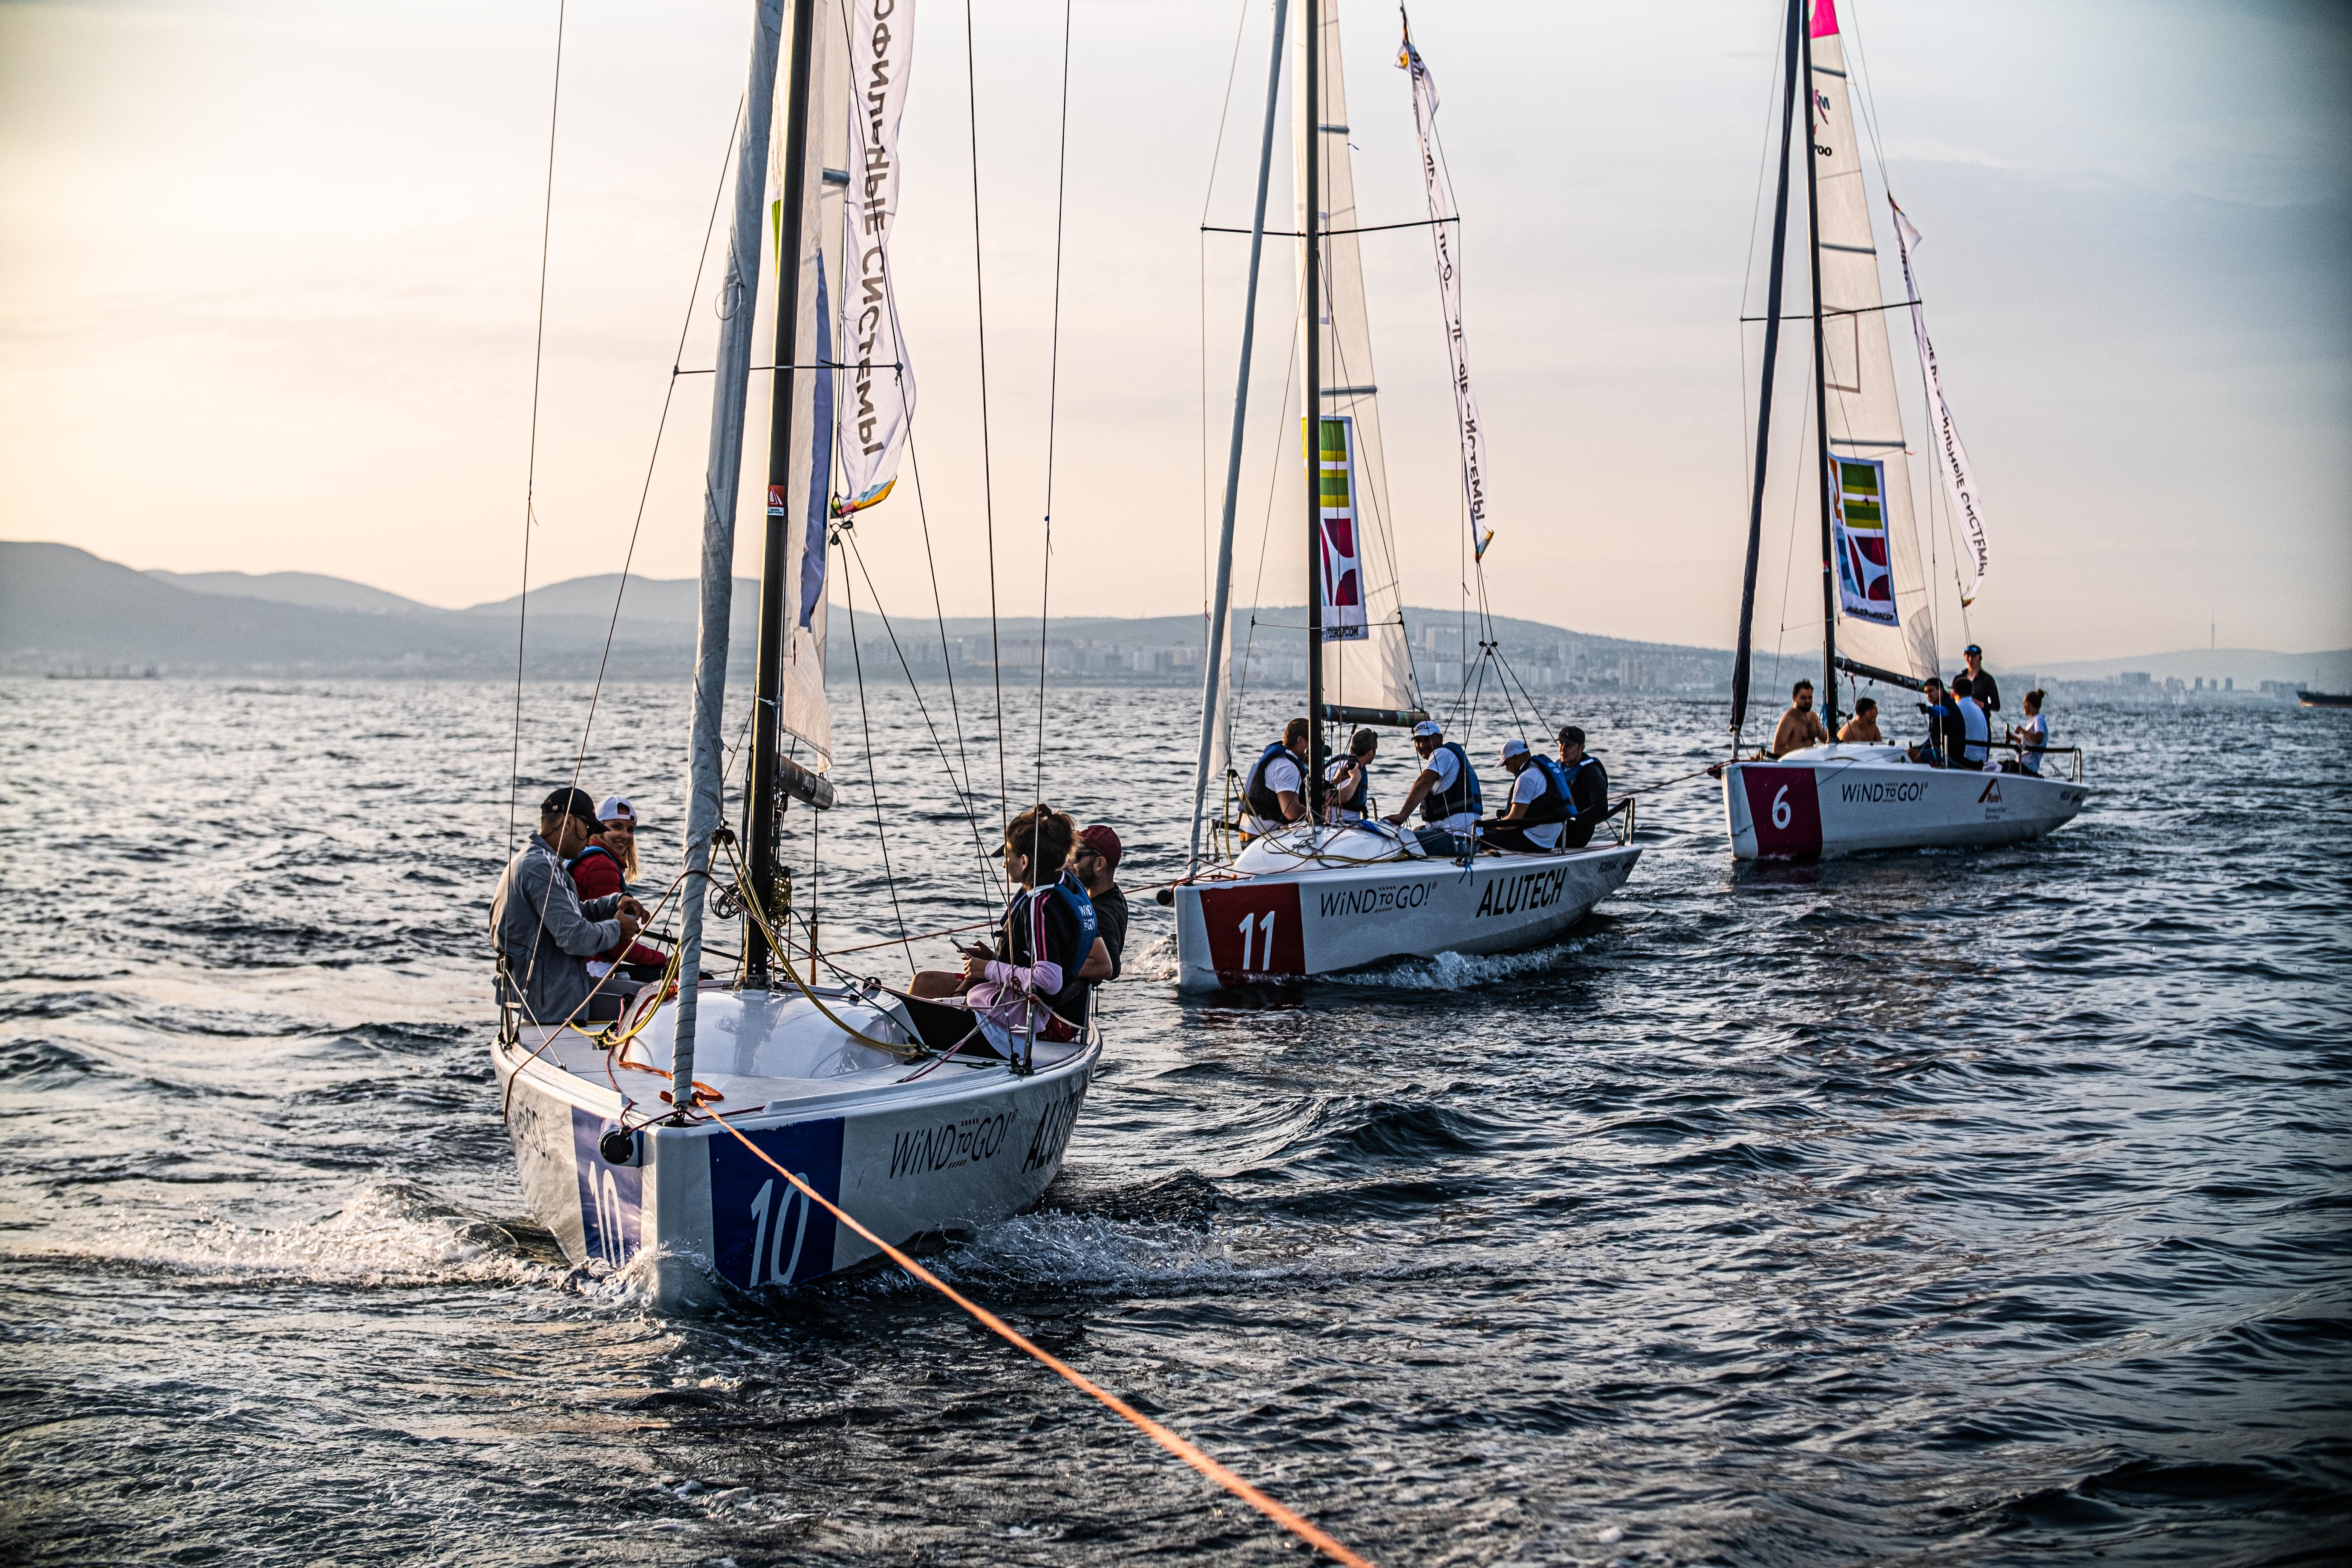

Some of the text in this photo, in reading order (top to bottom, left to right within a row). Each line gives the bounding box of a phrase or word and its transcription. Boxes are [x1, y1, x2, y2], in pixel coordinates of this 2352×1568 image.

[856, 246, 885, 456] СИСТЕМЫ
[1772, 785, 1791, 829] 6
[1886, 788, 1896, 798] TO
[1987, 793, 2000, 804] Roto
[1379, 893, 1393, 905] TO
[1476, 867, 1567, 918] ALUTECH
[1239, 911, 1275, 971] 11
[956, 1132, 972, 1155] TO
[588, 1161, 625, 1269] 10
[750, 1172, 809, 1289] 10
